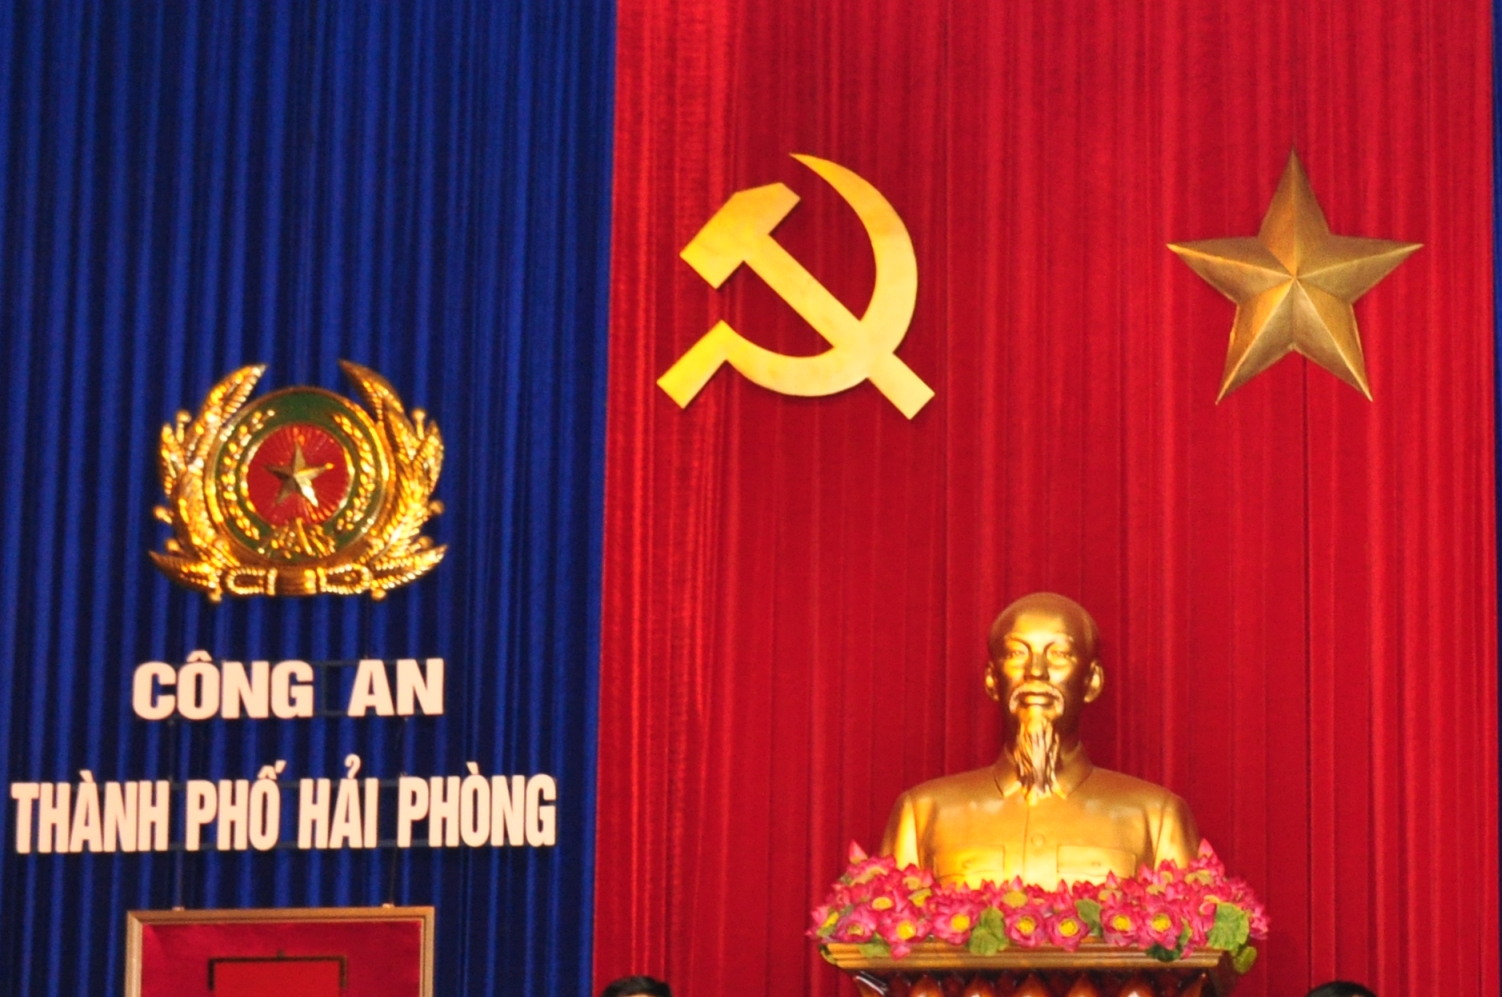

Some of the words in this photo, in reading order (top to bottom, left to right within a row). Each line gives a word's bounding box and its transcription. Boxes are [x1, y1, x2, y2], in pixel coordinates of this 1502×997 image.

[132, 650, 314, 720] CÔNG
[347, 658, 444, 717] AN
[11, 769, 170, 854] THÀNH
[185, 760, 287, 852] PHỐ
[298, 754, 379, 850] HẢI
[396, 761, 557, 848] PHÒNG
